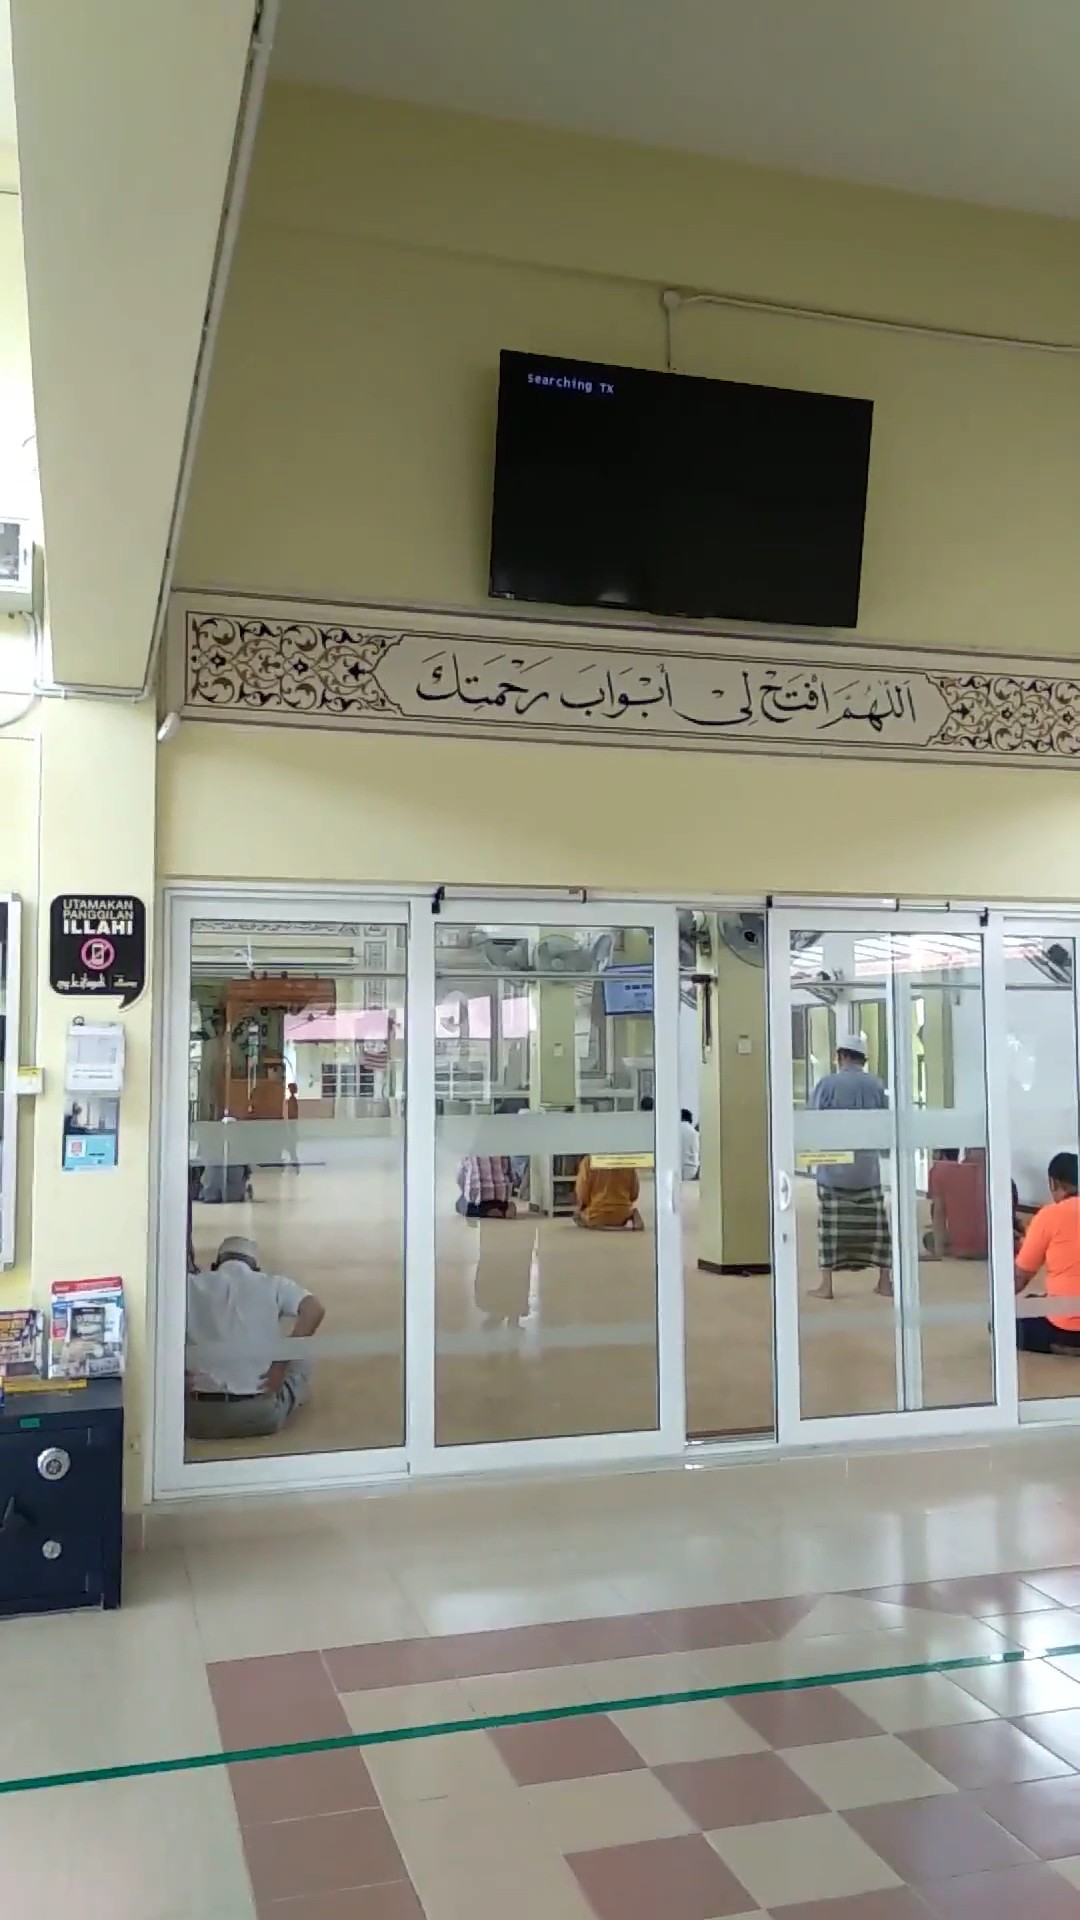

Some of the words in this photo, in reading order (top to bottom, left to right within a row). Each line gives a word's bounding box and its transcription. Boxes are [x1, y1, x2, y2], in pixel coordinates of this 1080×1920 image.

[599, 382, 614, 394] TX
[63, 899, 133, 910] UTAMAKAN
[63, 909, 134, 920] PANGGILAN
[63, 919, 133, 935] ILLAHI
